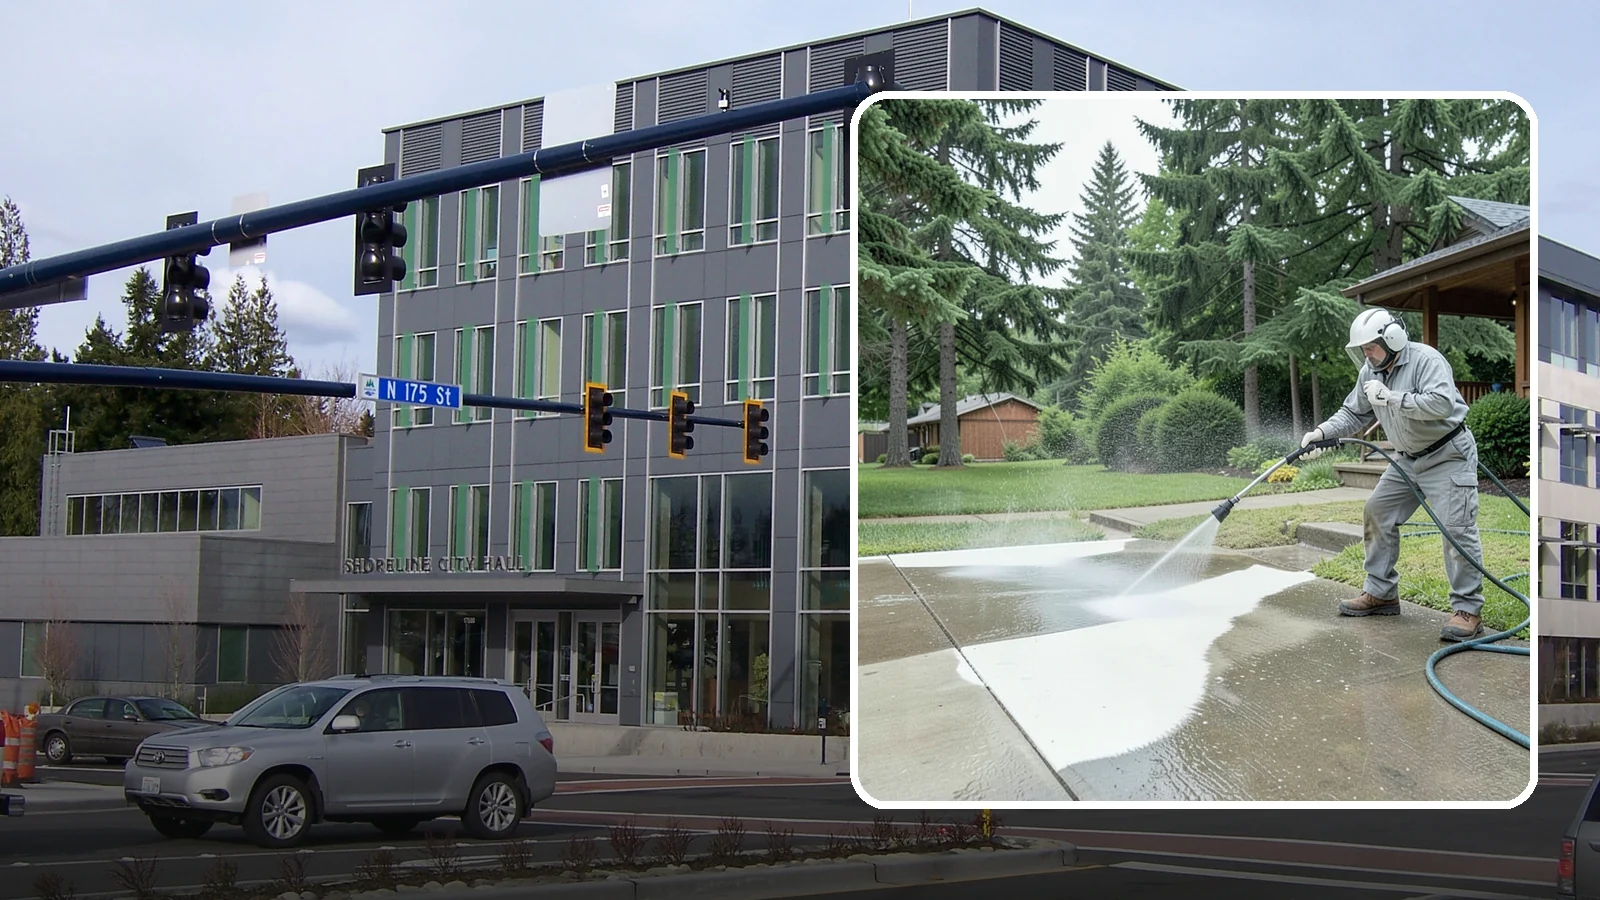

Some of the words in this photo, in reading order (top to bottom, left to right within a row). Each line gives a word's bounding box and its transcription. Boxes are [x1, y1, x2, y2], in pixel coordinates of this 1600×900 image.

[387, 380, 396, 400] N
[405, 382, 427, 403] 175
[436, 386, 451, 406] St
[344, 557, 431, 574] SHORELINE
[438, 556, 475, 572] CITY
[483, 556, 525, 571] HALL
